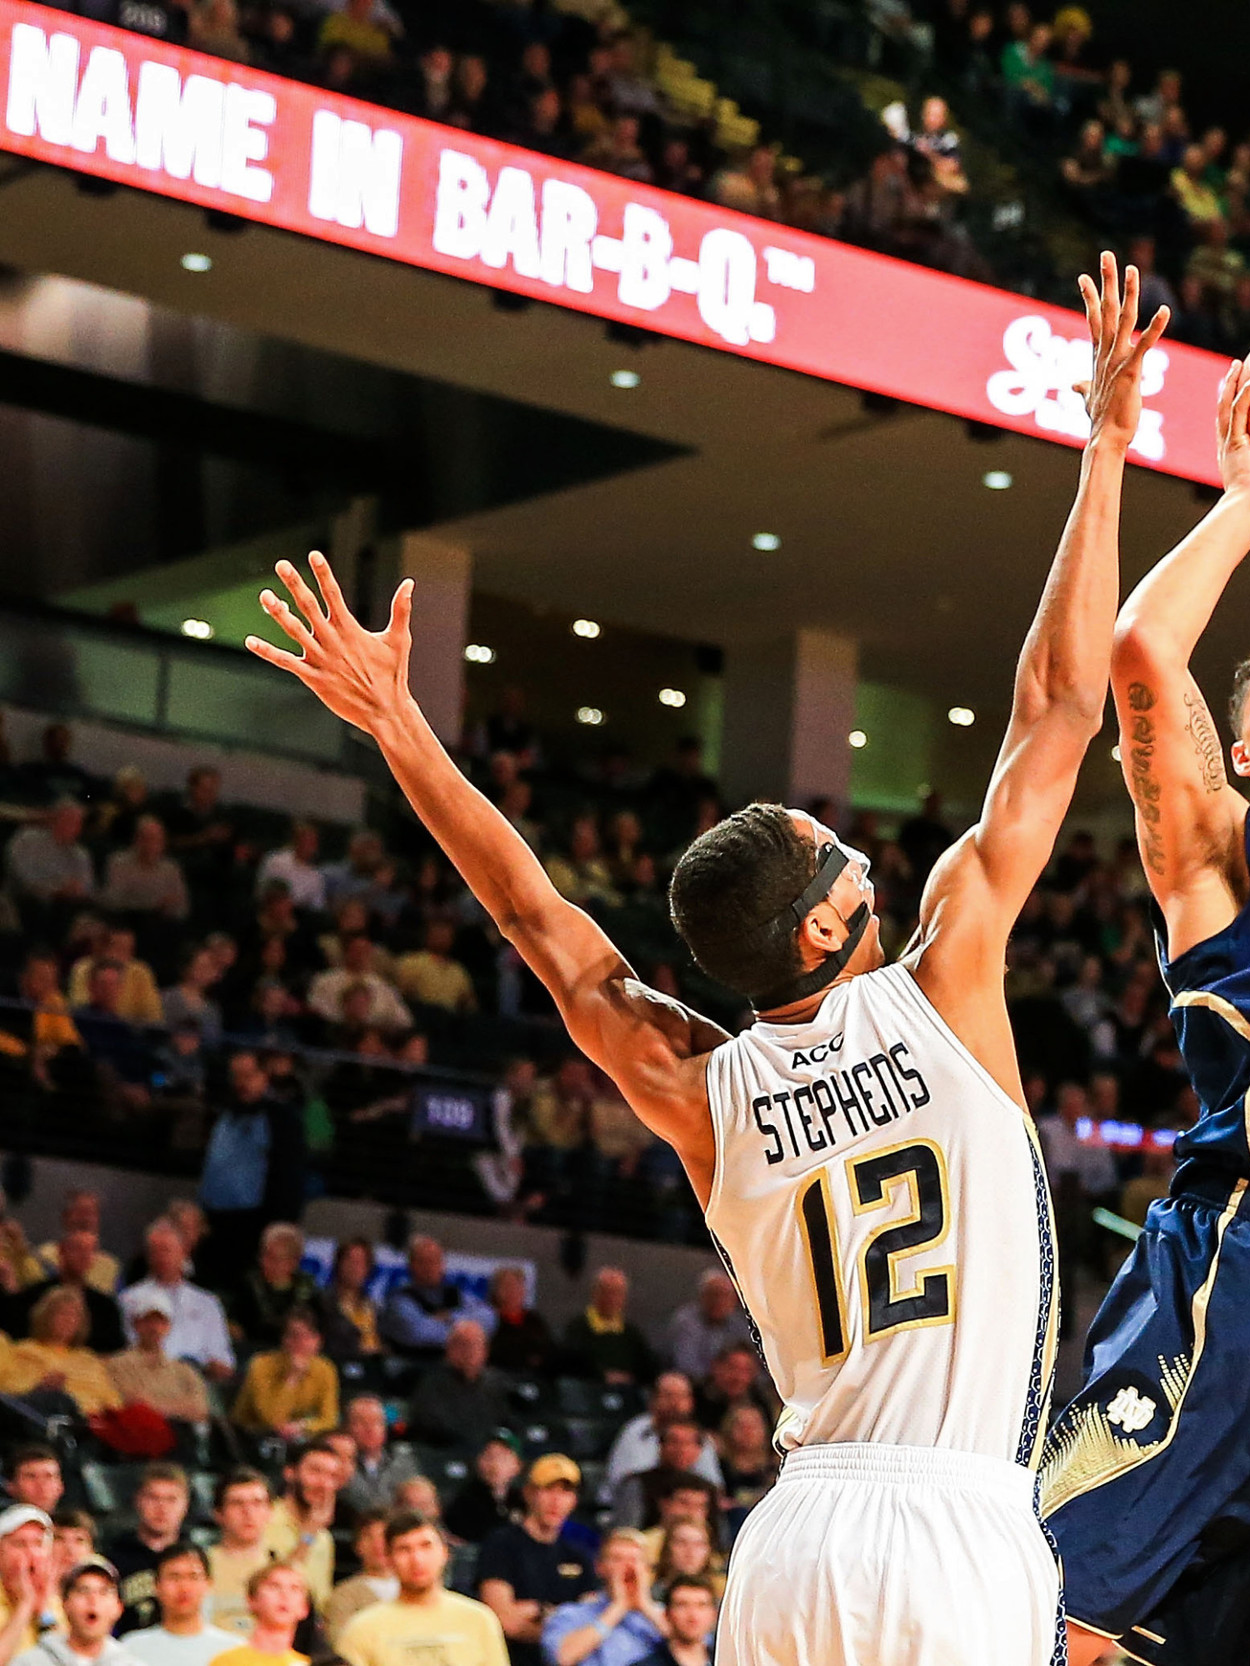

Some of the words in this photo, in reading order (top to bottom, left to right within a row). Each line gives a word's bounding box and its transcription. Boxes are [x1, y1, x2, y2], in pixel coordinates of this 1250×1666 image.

[6, 22, 277, 202] NAME
[308, 109, 403, 238] IN
[752, 1042, 931, 1165] STEPHENS
[791, 1032, 845, 1069] ACC
[794, 1137, 956, 1368] 12
